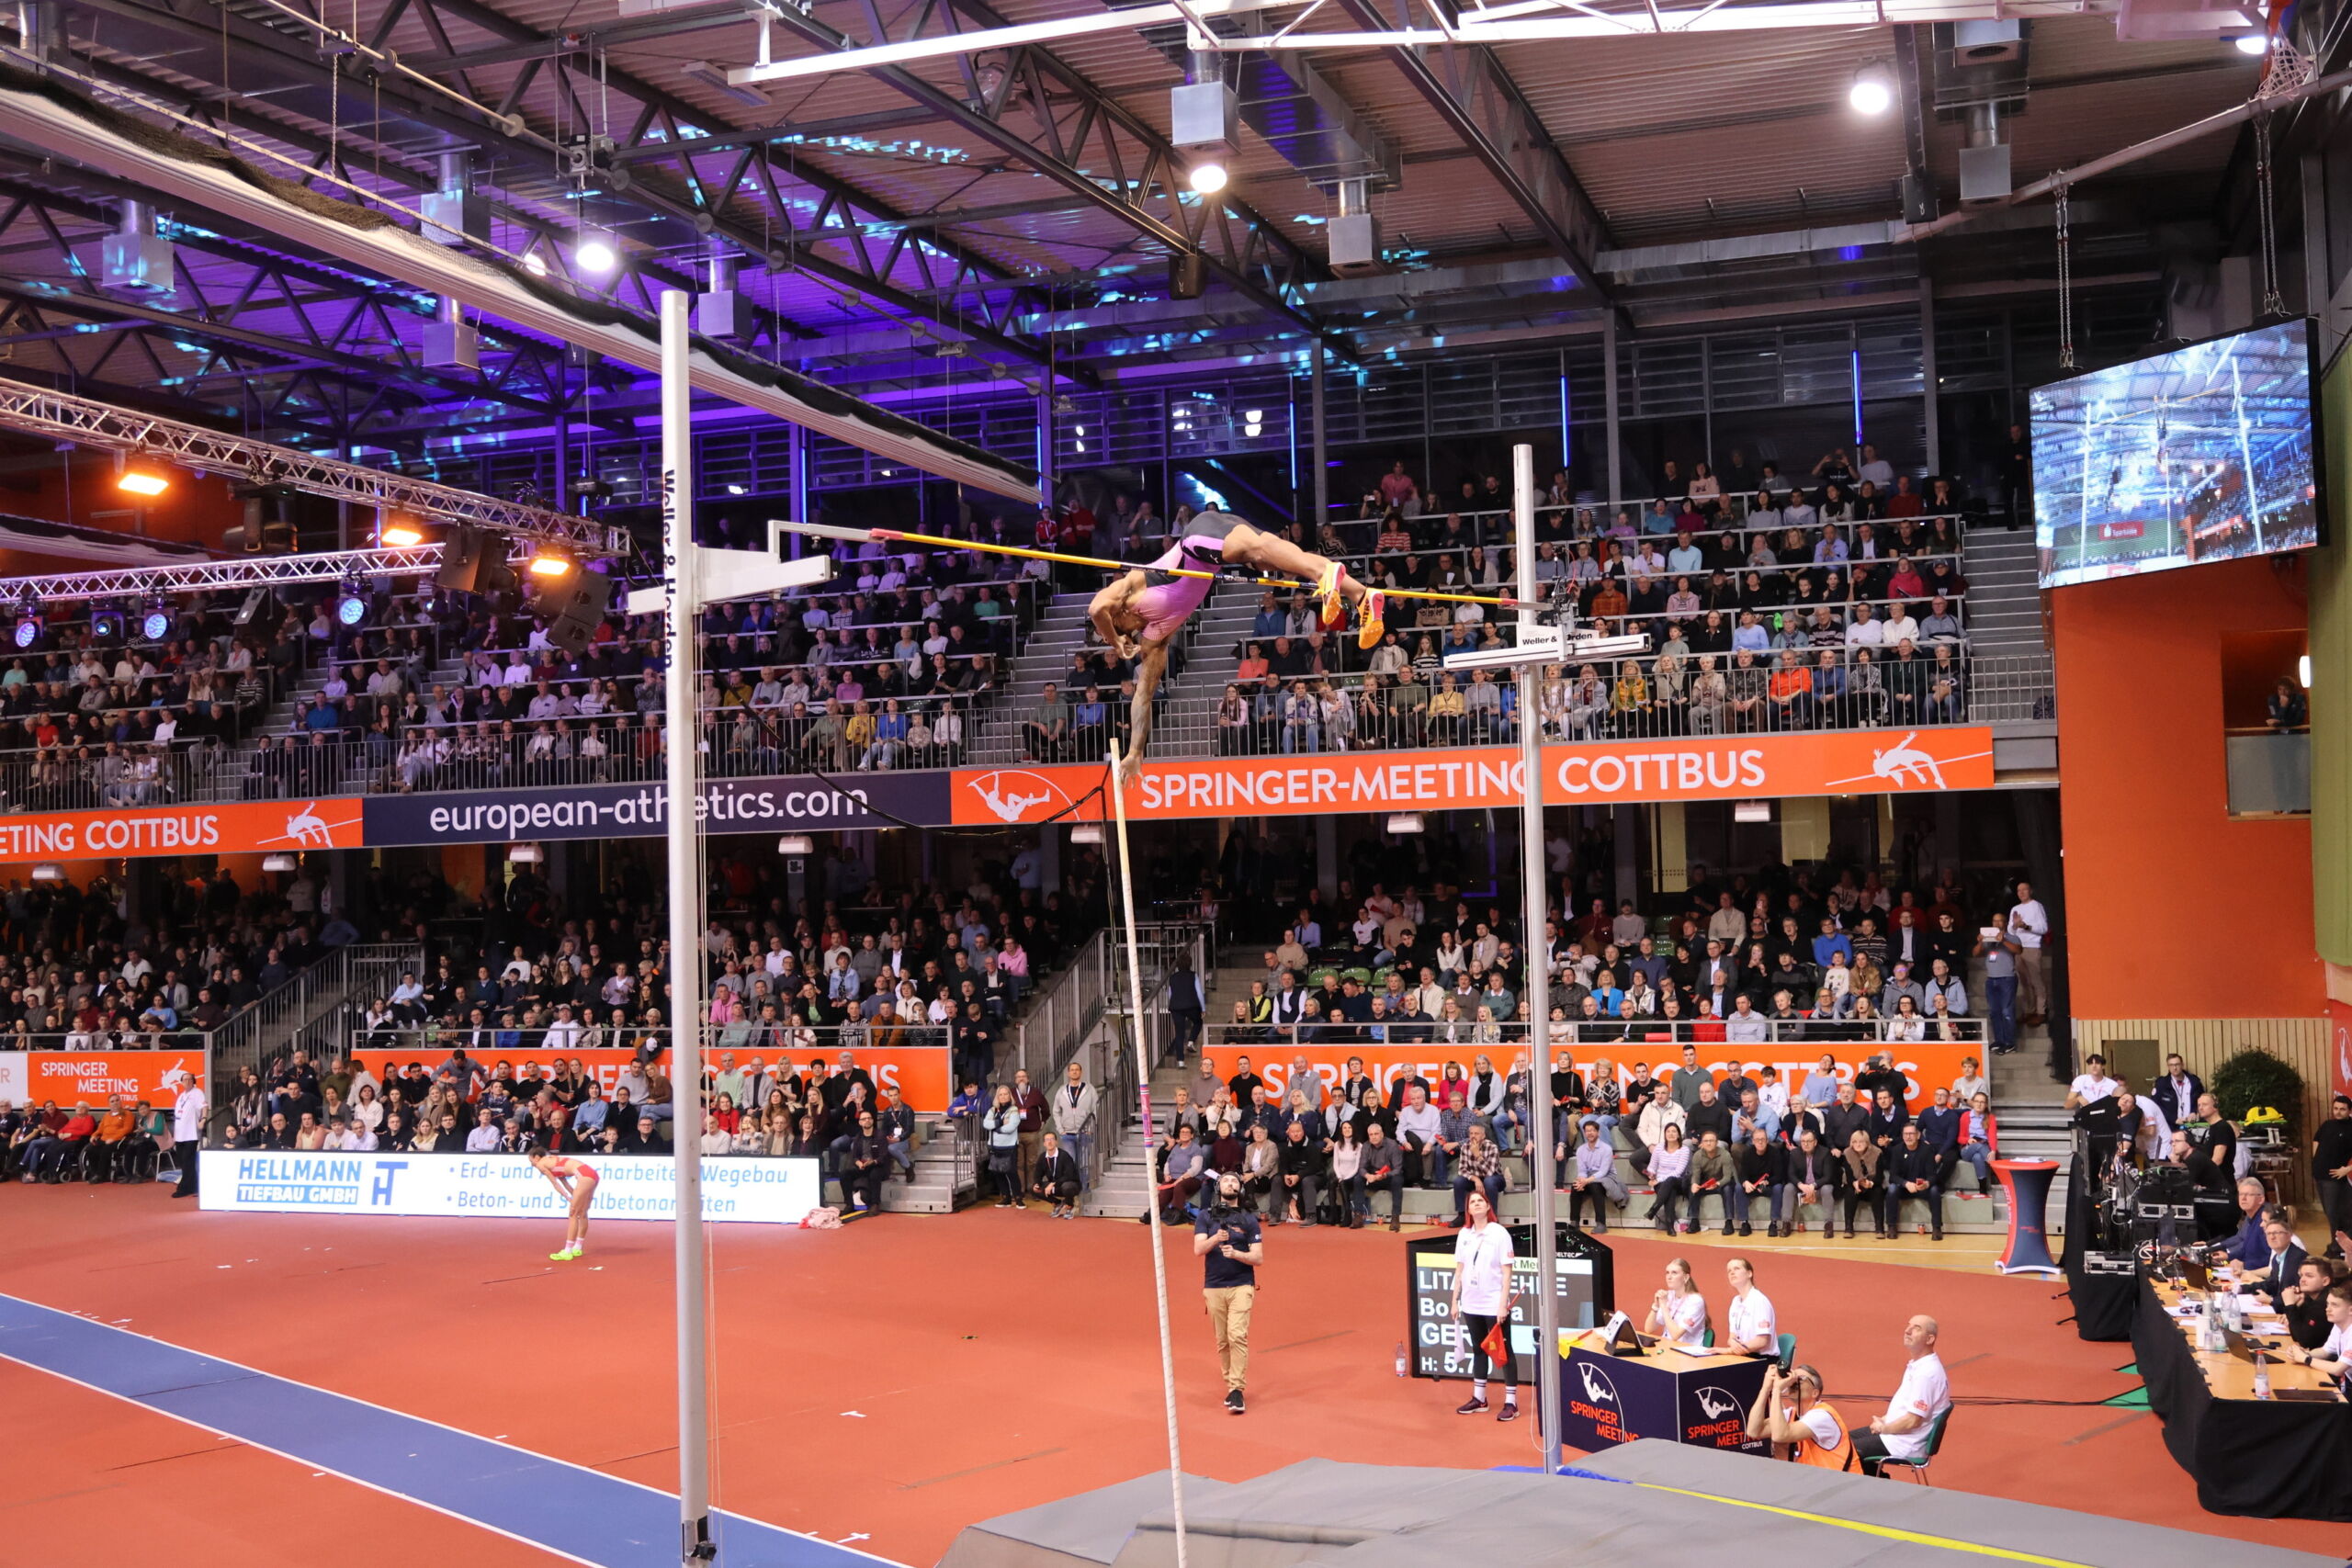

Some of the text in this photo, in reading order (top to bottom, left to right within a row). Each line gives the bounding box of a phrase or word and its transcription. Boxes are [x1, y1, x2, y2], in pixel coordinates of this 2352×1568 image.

[1522, 637, 1549, 646] Weller
[1558, 750, 1766, 794] COTTBUS
[430, 783, 868, 840] european-athetics.com
[85, 815, 219, 850] COTTBUS
[41, 1062, 107, 1077] SPRINGER
[77, 1078, 138, 1093] MEETING
[238, 1158, 362, 1182] HELLMANN
[461, 1161, 495, 1179] Erd-
[502, 1164, 533, 1179] und
[701, 1164, 788, 1188] Wegebau
[239, 1185, 357, 1204] TIEFBAU GMBH
[458, 1191, 514, 1208] Beton-
[520, 1191, 553, 1209] und
[1419, 1297, 1449, 1317] Bo
[1421, 1351, 1493, 1374] H: 5.7
[1570, 1401, 1618, 1426] SPRINGER
[1688, 1419, 1739, 1439] SPRINGER
[1741, 1440, 1763, 1450] COTTBUS
